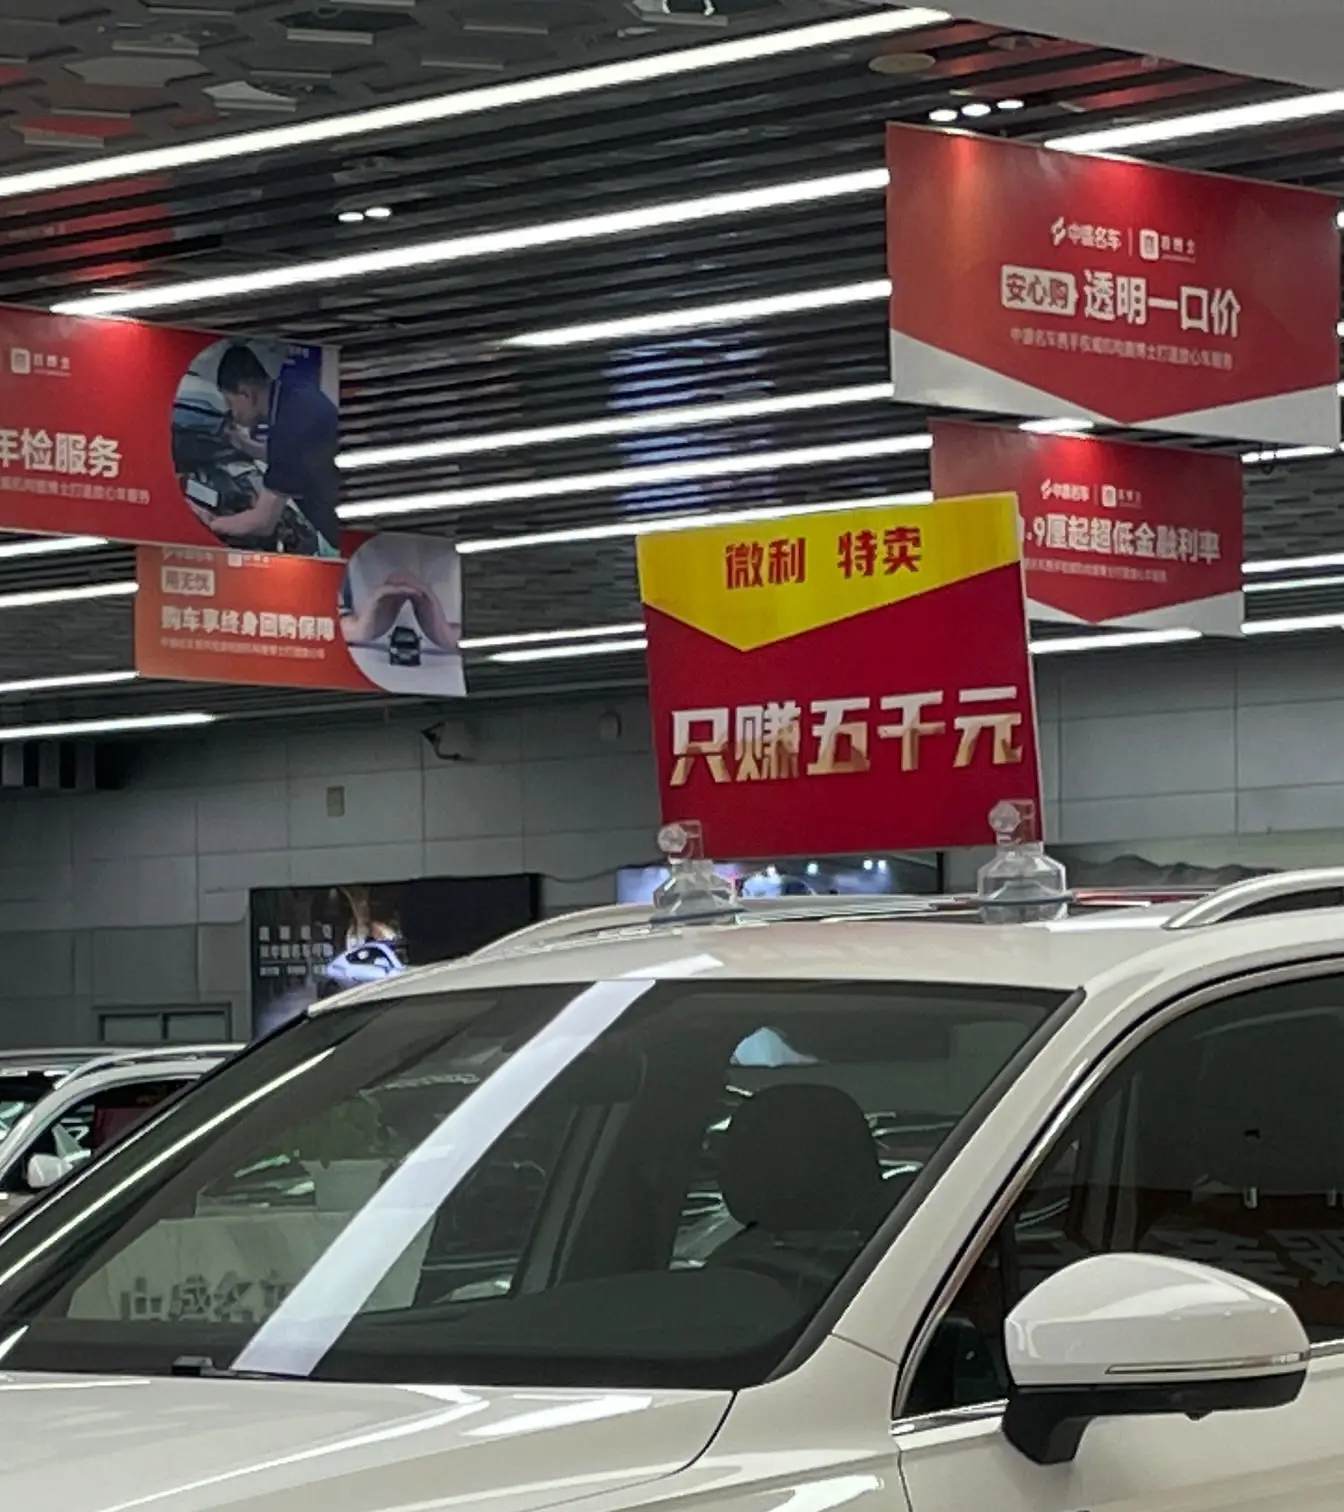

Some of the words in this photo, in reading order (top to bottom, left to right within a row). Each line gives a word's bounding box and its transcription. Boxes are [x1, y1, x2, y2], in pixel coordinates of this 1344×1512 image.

[1005, 272, 1069, 310] 安心购
[1083, 268, 1241, 338] 透明一口价
[724, 536, 806, 591] 微利
[837, 526, 923, 579] 特卖
[1019, 512, 1221, 565] .9厘起超低金融利率
[669, 685, 1025, 788] 只赚五千元
